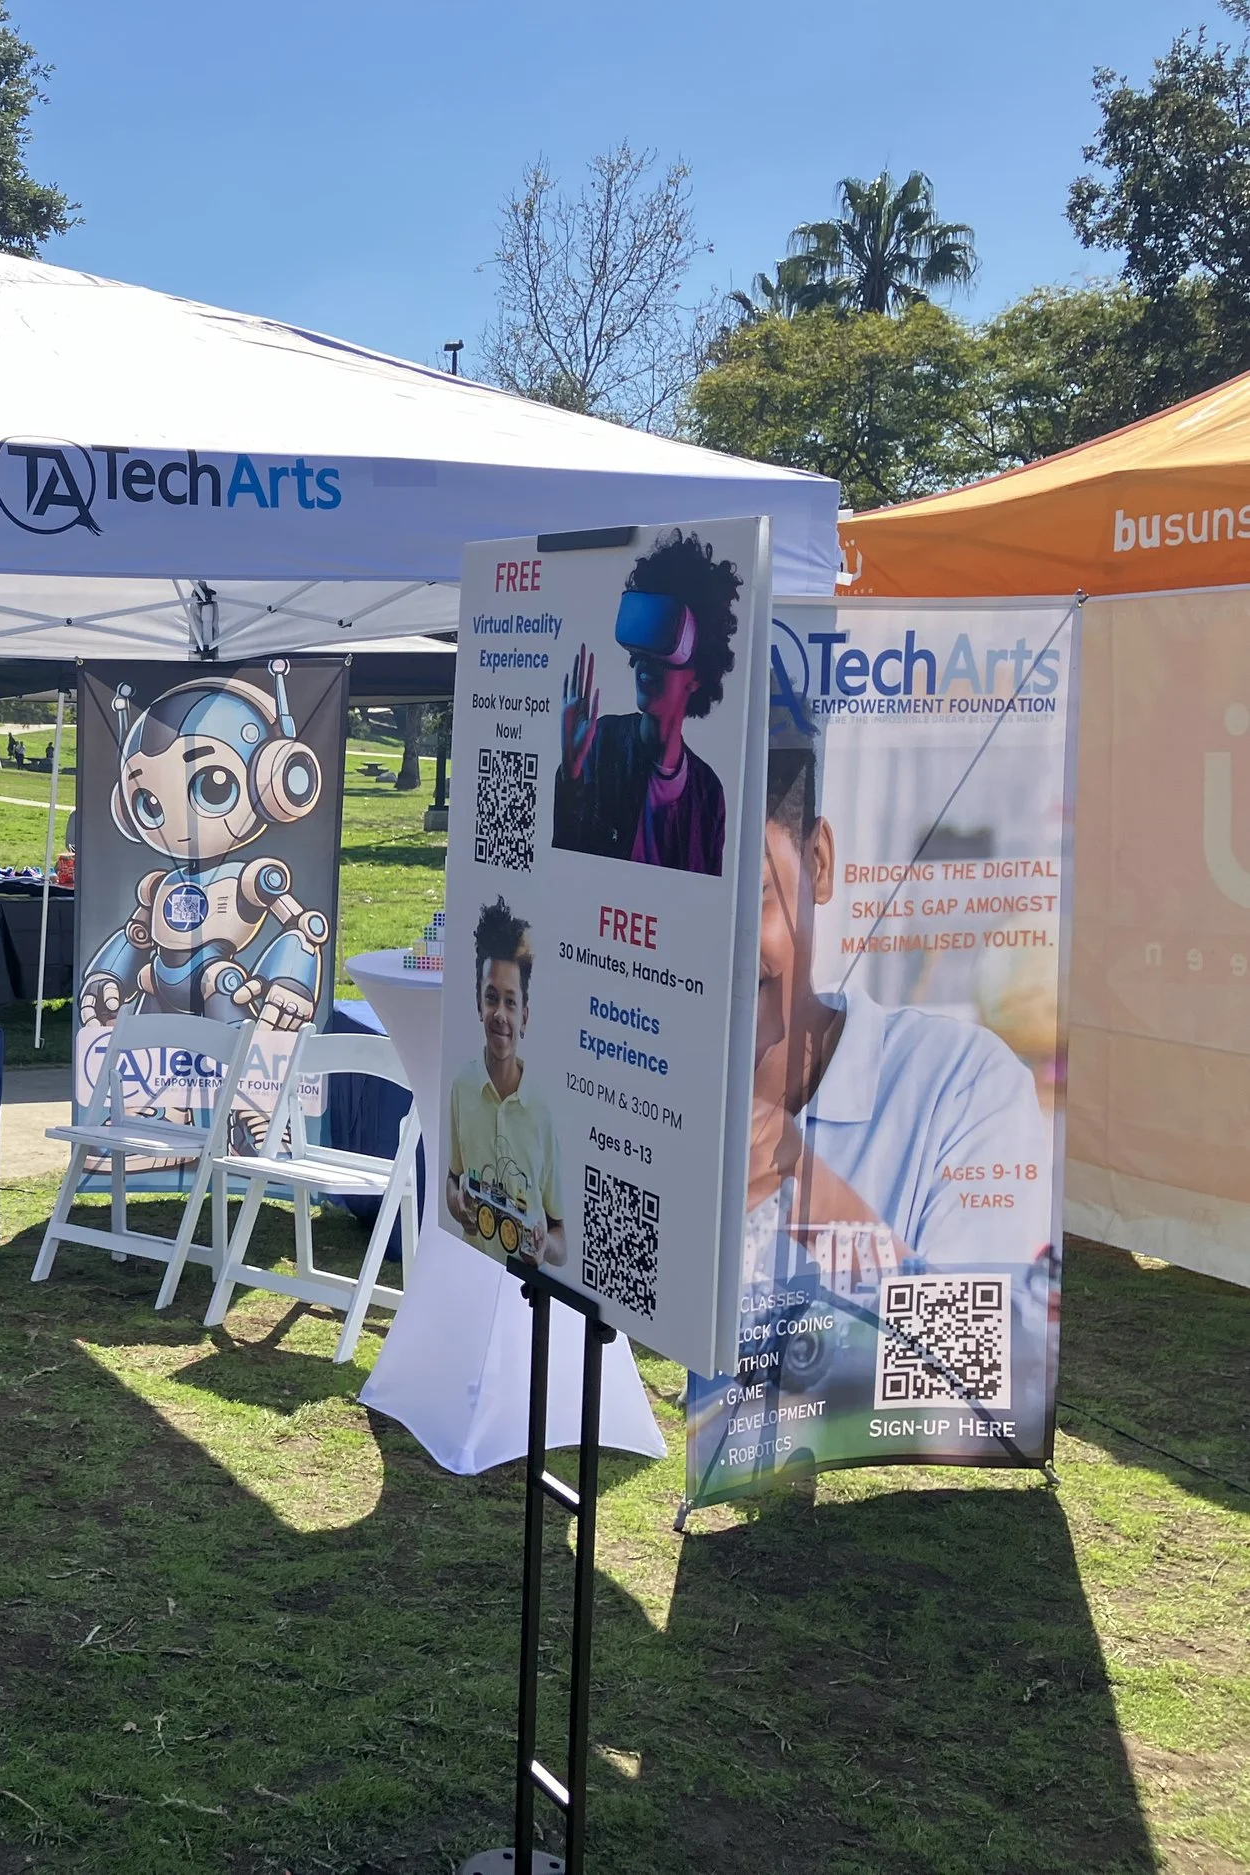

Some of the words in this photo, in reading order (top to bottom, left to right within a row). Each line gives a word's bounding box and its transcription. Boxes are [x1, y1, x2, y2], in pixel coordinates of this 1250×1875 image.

[91, 444, 342, 510] TechArts
[495, 560, 542, 592] FREE
[473, 614, 513, 634] Virtual
[516, 613, 562, 640] Reality
[479, 647, 549, 673] Experience
[808, 630, 1060, 697] TechArts
[472, 693, 496, 710] Book
[499, 695, 523, 711] Your
[525, 696, 550, 717] Spot
[812, 698, 944, 715] EMPOWERMENT
[950, 697, 1056, 714] FOUNDATION
[496, 723, 522, 740] Now!
[844, 863, 934, 883] BRIDGING
[942, 863, 976, 880] THE
[983, 861, 1058, 879] DIGITAL
[852, 899, 914, 919] SKILLS
[922, 898, 958, 915] GAP
[964, 895, 1058, 914] AMONGST
[599, 905, 658, 950] FREE
[841, 931, 976, 954] MARGINALISED
[983, 930, 1054, 948] YOUTH.
[559, 942, 574, 960] 30
[576, 946, 630, 978] Minutes,
[632, 961, 704, 995] Hands-on
[589, 996, 660, 1035] Robotics
[579, 1029, 669, 1076] Experience
[154, 1077, 245, 1089] EMPOWERMT
[565, 1072, 594, 1097] 12:00
[597, 1084, 616, 1106] PM
[618, 1092, 628, 1110] &
[631, 1097, 659, 1121] 3:00
[662, 1108, 682, 1130] PM
[589, 1126, 620, 1151] Ages
[624, 1139, 652, 1164] 8-13
[941, 1166, 986, 1181] AGES
[992, 1164, 1038, 1180] 9-18
[959, 1192, 1014, 1208] YEARS
[740, 1290, 810, 1314] CLASSES:
[776, 1315, 834, 1336] CODING
[736, 1352, 779, 1374] YTHON
[727, 1383, 764, 1406] GAME
[727, 1400, 826, 1436] DEVELOPMENT
[869, 1419, 950, 1438] SIGN-UP
[958, 1418, 1016, 1438] HERE
[728, 1435, 792, 1466] ROBOTICS
